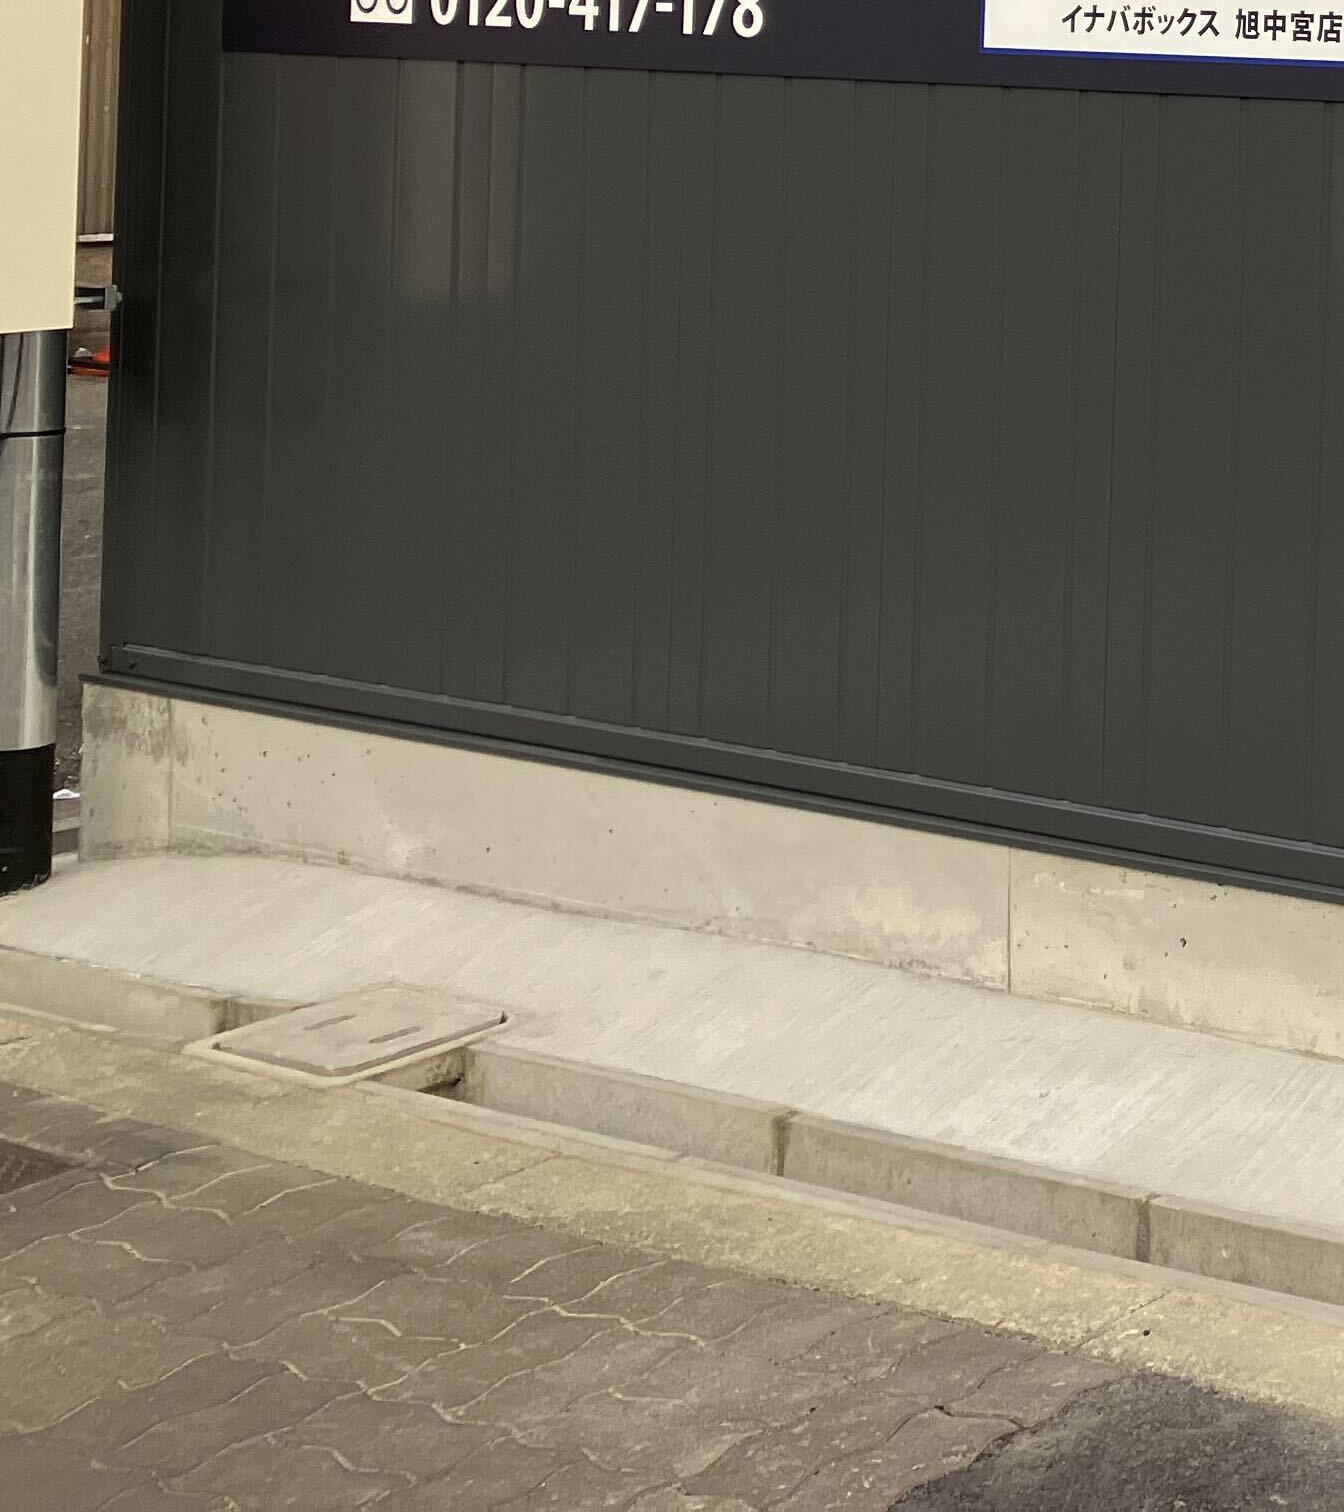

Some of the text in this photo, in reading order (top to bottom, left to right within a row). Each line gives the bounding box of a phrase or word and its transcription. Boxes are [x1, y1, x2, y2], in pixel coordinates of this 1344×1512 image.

[1061, 5, 1344, 44] イナバボックス 旭中宮店
